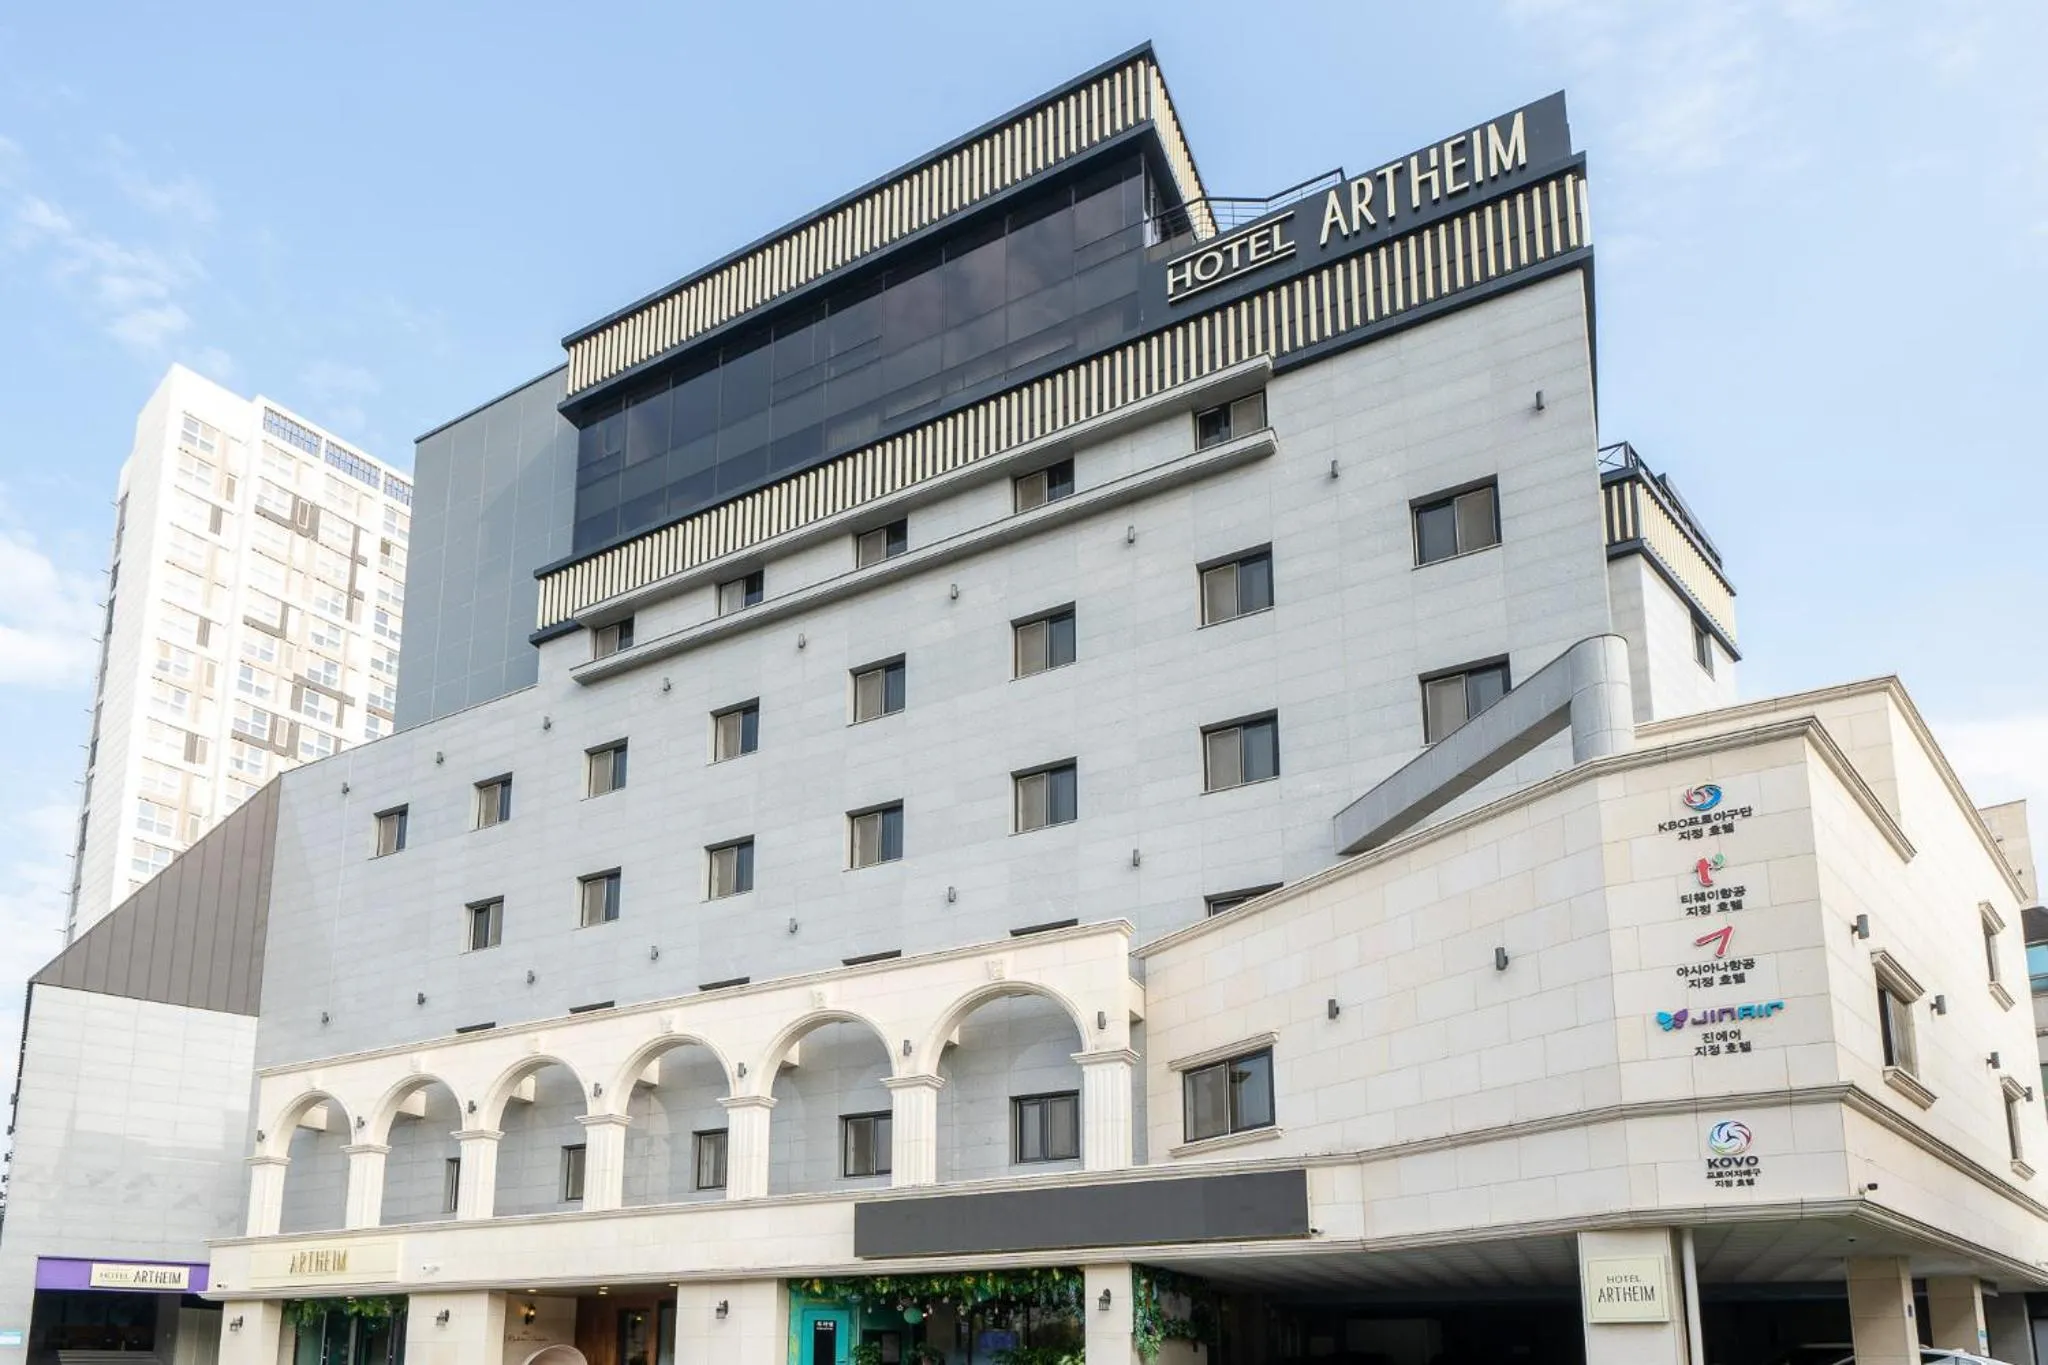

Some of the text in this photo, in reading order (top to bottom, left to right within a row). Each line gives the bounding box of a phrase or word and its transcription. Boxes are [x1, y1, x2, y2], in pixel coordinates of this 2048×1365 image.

[1167, 111, 1527, 298] HOTEL ARTHEIM
[1658, 806, 1753, 832] KBO프로야구단
[1678, 822, 1734, 840] 지정 호텔
[1686, 899, 1743, 916] 지정 호텔
[1676, 958, 1756, 977] 아시아나항공
[1689, 973, 1746, 989] 지정 호텔
[1702, 1029, 1741, 1044] 진에어
[1695, 1041, 1751, 1056] 지정 호텔
[1707, 1156, 1759, 1169] KOVO
[1715, 1178, 1754, 1188] 지정 호텔
[289, 1249, 347, 1274] ARTHEIM
[133, 1270, 181, 1284] ARTHEIM
[1606, 1275, 1641, 1284] HOTEL
[1598, 1286, 1655, 1303] ARTHEIM
